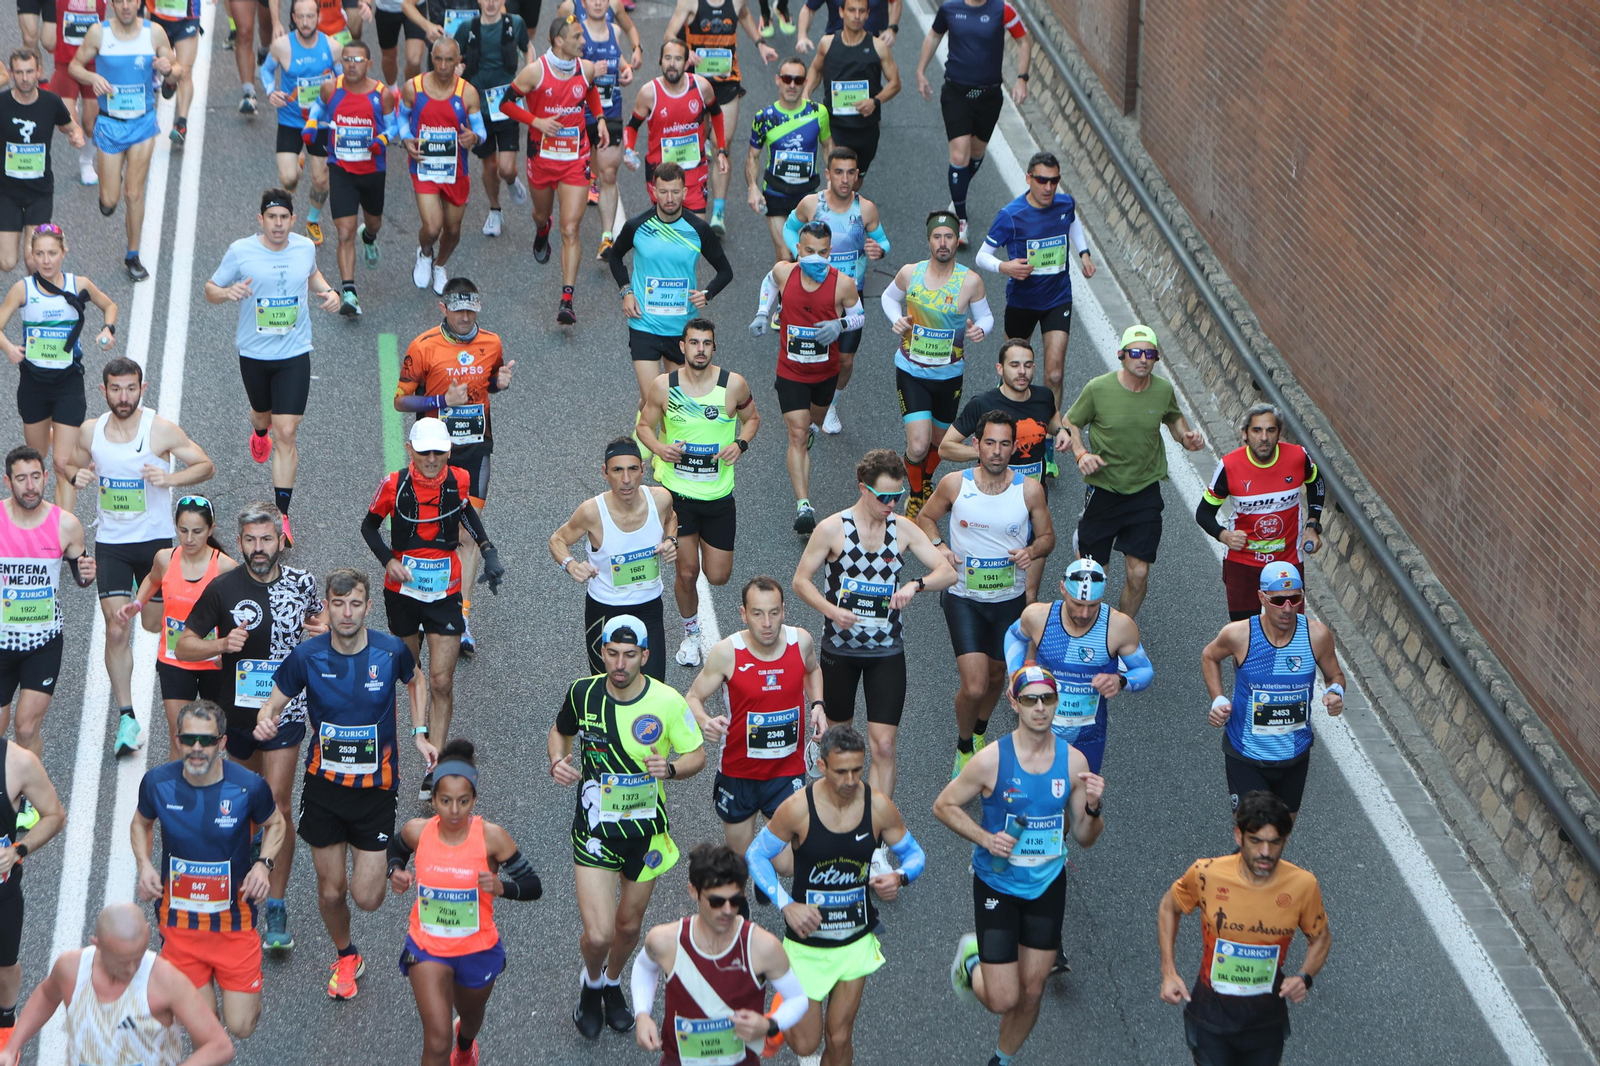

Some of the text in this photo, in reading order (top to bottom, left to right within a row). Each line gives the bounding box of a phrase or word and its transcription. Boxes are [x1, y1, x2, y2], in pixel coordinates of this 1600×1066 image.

[336, 113, 372, 125] Pequiven
[674, 136, 694, 146] ZURICH
[428, 143, 446, 152] GUIA
[1042, 240, 1062, 248] ZURICH
[272, 298, 294, 306] ZURICH
[926, 330, 949, 338] ZURICH
[456, 406, 479, 415] ZURICH
[688, 457, 703, 465] 2443
[676, 464, 694, 472] ALVARO
[628, 550, 654, 561] ZURICH
[1254, 551, 1275, 563] ibp
[419, 561, 444, 569] ZURICH
[983, 559, 1009, 567] ZURICH
[0, 564, 47, 576] ENTRENA
[629, 565, 645, 574] 1687
[418, 575, 433, 584] 3961
[631, 574, 646, 582] BAKS
[983, 574, 998, 582] 1941
[418, 584, 433, 592] KEVIN
[860, 584, 888, 594] ZURICH
[20, 590, 47, 599] ZURICH
[20, 606, 37, 614] 1922
[852, 607, 876, 617] WILLIAM
[8, 614, 49, 622] JUANPACOACH
[1052, 669, 1080, 679] Atletismo
[255, 679, 272, 687] 5014
[1258, 682, 1290, 690] Atletismo
[1064, 685, 1094, 694] ZURICH
[1273, 694, 1302, 702] ZURICH
[1062, 700, 1079, 708] 4149
[767, 712, 794, 723] ZURICH
[1272, 709, 1290, 717] 2453
[1267, 718, 1284, 726] JUAN
[338, 729, 369, 738] ZURICH
[767, 730, 784, 739] 2340
[766, 740, 786, 748] GALLO
[338, 745, 357, 754] 2539
[341, 755, 356, 763] XAVI
[621, 792, 639, 801] 1373
[1027, 819, 1056, 829] ZURICH
[1024, 837, 1043, 846] 4136
[1020, 848, 1045, 856] MONIKA
[189, 865, 222, 874] ZURICH
[191, 882, 206, 891] 847
[437, 892, 470, 901] ZURICH
[829, 893, 858, 904] ZURICH
[1222, 922, 1244, 931] LOS
[1237, 947, 1271, 957] ZURICH
[1235, 964, 1254, 973] 2041
[1217, 972, 1229, 981] TAL
[1230, 974, 1251, 983] COMO
[696, 1020, 732, 1032] ZURICH
